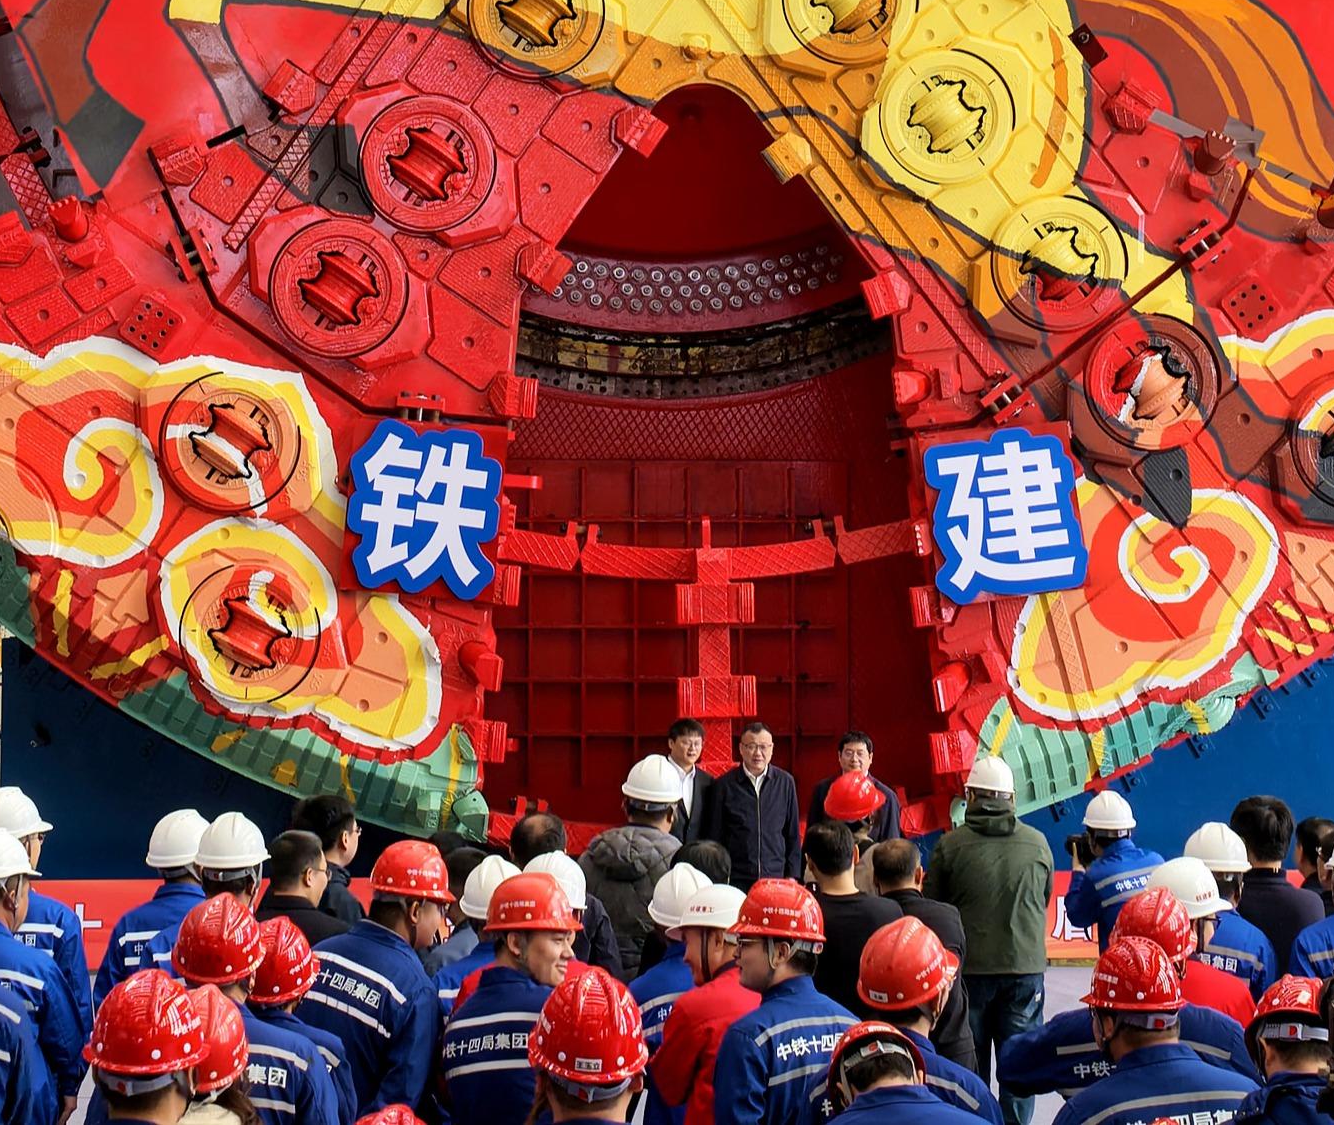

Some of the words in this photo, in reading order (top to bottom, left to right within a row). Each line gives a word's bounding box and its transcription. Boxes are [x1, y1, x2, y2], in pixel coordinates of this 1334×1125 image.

[359, 432, 491, 589] 铁
[938, 440, 1077, 592] 建
[442, 1032, 529, 1059] 铁十四局集团
